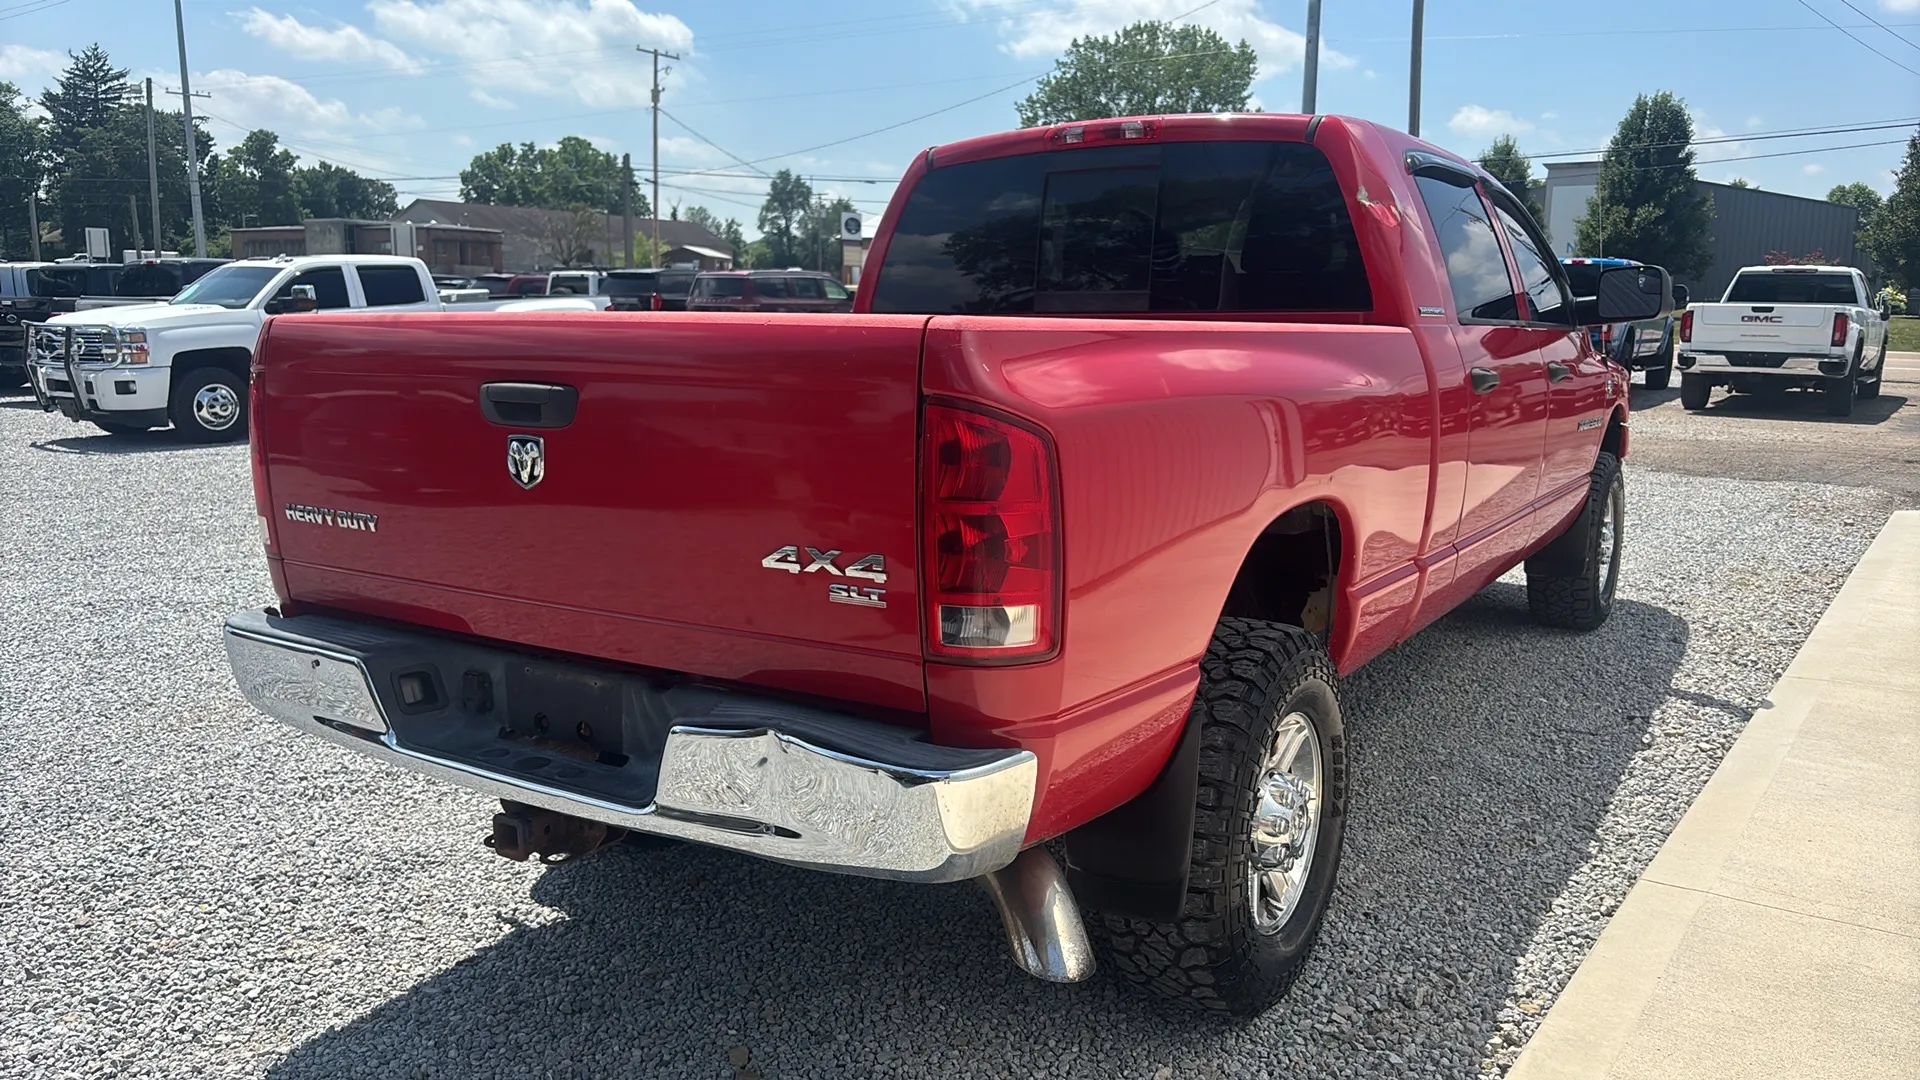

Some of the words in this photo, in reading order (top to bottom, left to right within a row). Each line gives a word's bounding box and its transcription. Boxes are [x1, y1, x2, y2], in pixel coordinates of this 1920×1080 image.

[1741, 315, 1783, 323] GMC
[285, 503, 335, 526] HEAVY
[336, 510, 378, 533] DUTY
[829, 583, 887, 603] SLT
